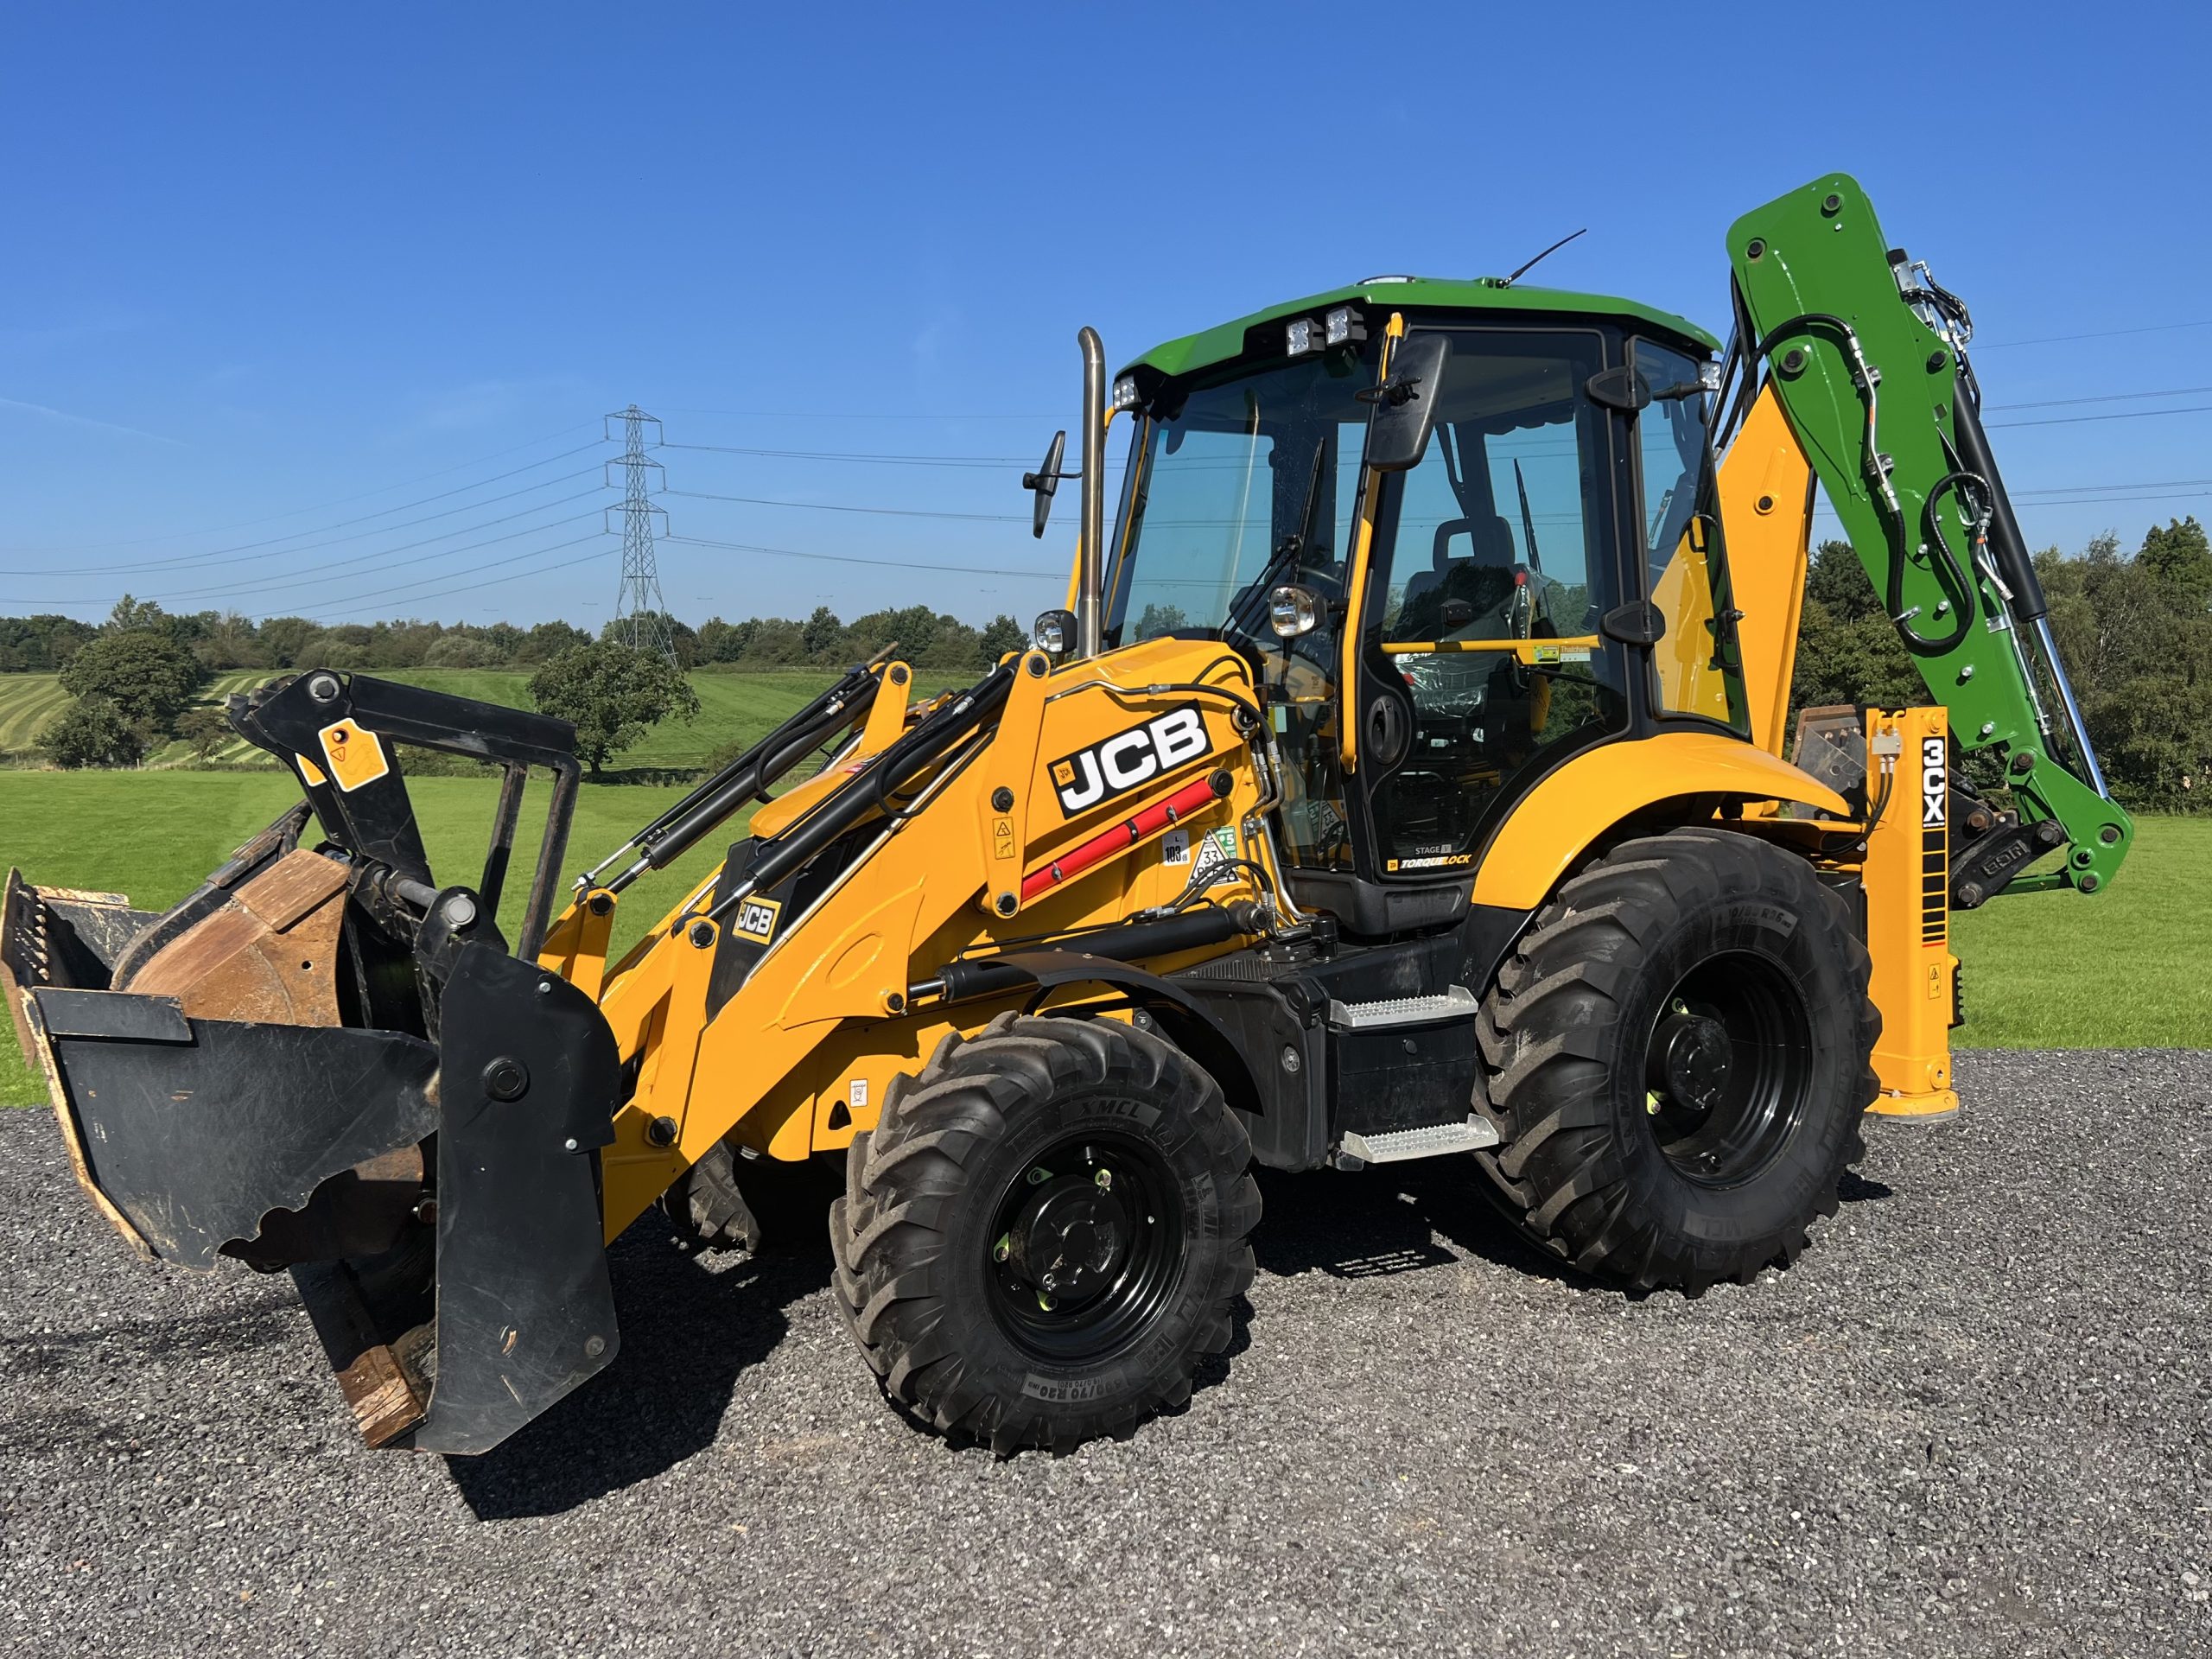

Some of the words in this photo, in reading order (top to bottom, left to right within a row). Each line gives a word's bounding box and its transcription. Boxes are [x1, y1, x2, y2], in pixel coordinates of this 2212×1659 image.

[1061, 709, 1207, 810] JCB
[1923, 739, 1945, 822] 3CX
[1165, 845, 1181, 862] 103
[1204, 850, 1218, 864] 33
[1415, 846, 1440, 855] STAGE
[1400, 855, 1472, 869] TORQUELOCK
[738, 904, 773, 934] JCB
